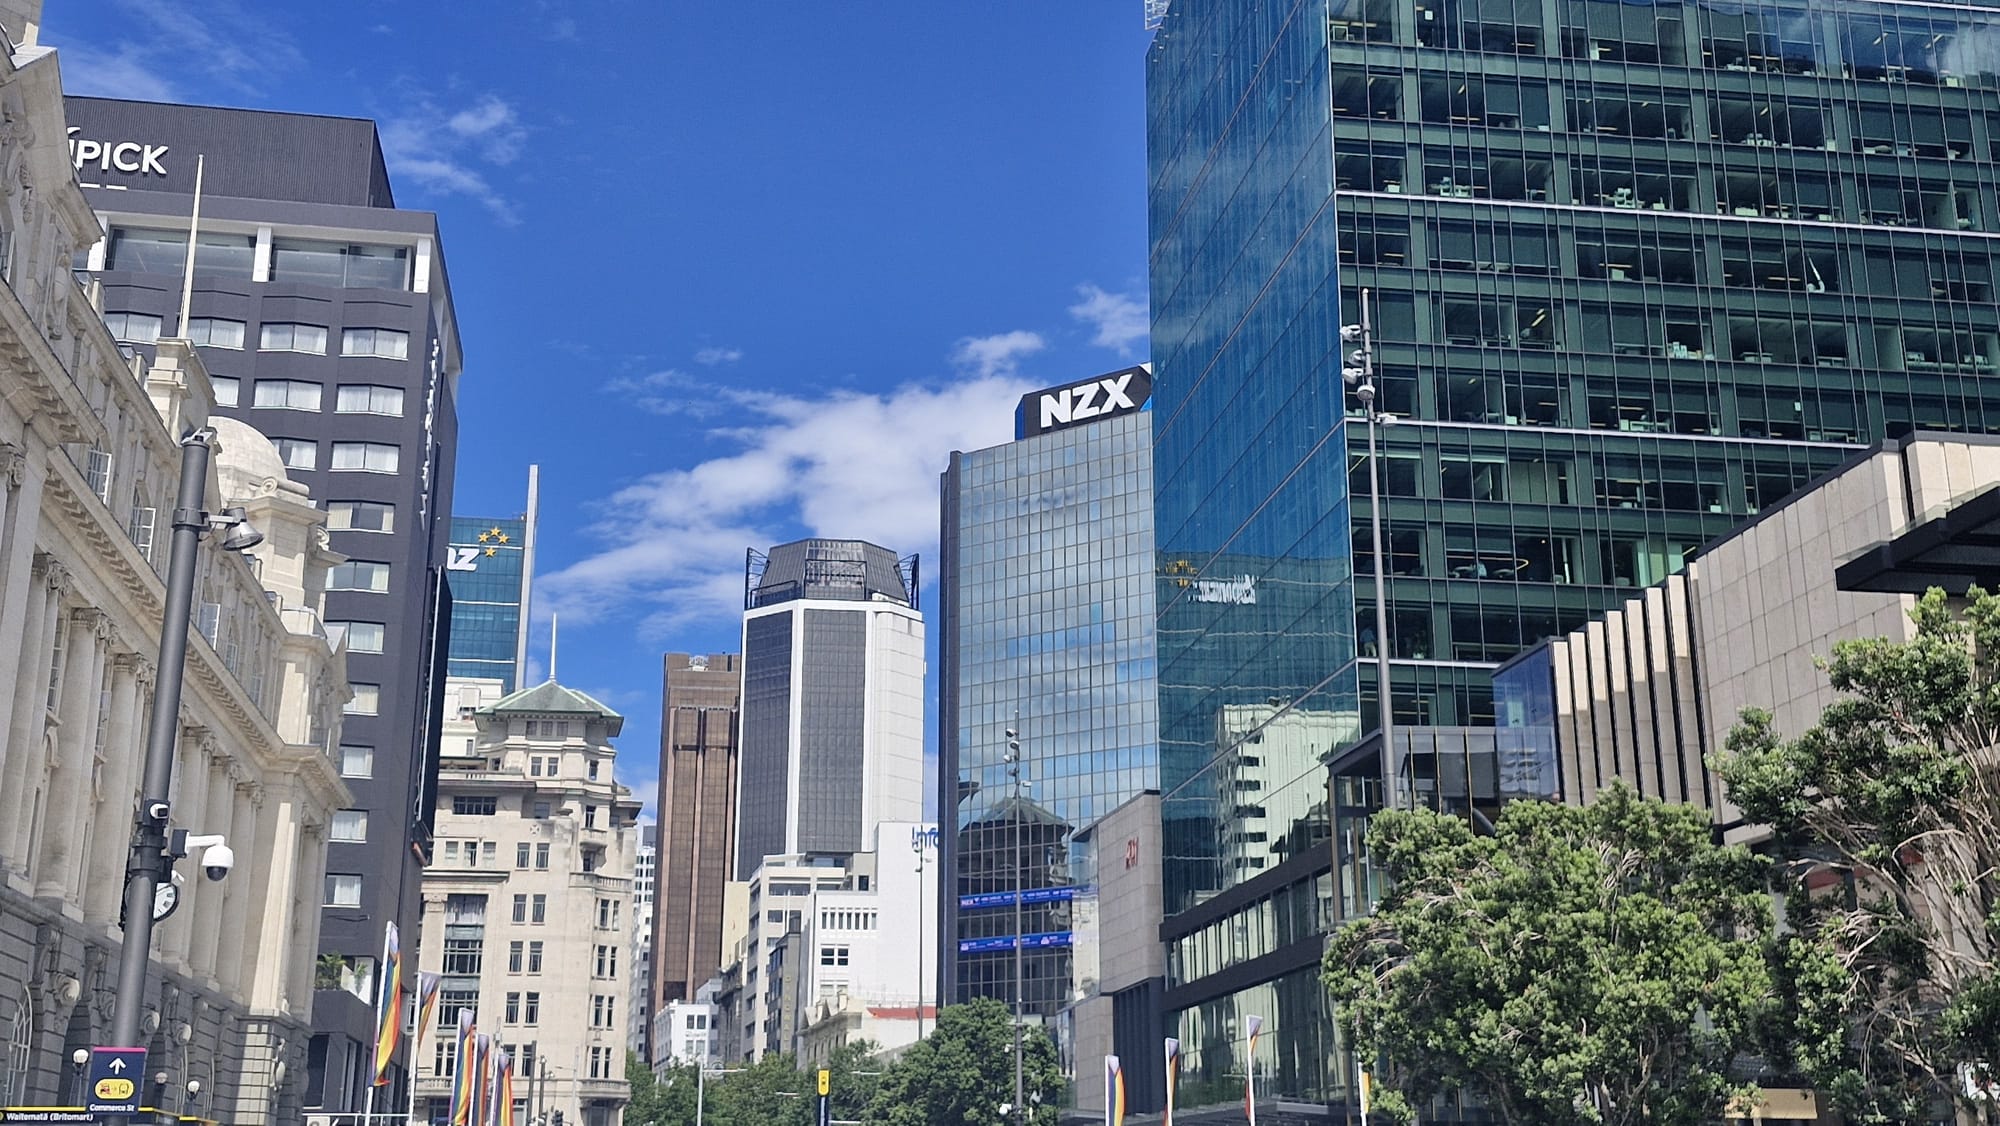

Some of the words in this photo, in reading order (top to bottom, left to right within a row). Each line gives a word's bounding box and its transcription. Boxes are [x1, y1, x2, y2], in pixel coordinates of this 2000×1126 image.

[1040, 373, 1136, 428] NZX
[89, 1103, 126, 1112] Commerce
[126, 1104, 135, 1112] St
[50, 1112, 93, 1122] (Britomart)
